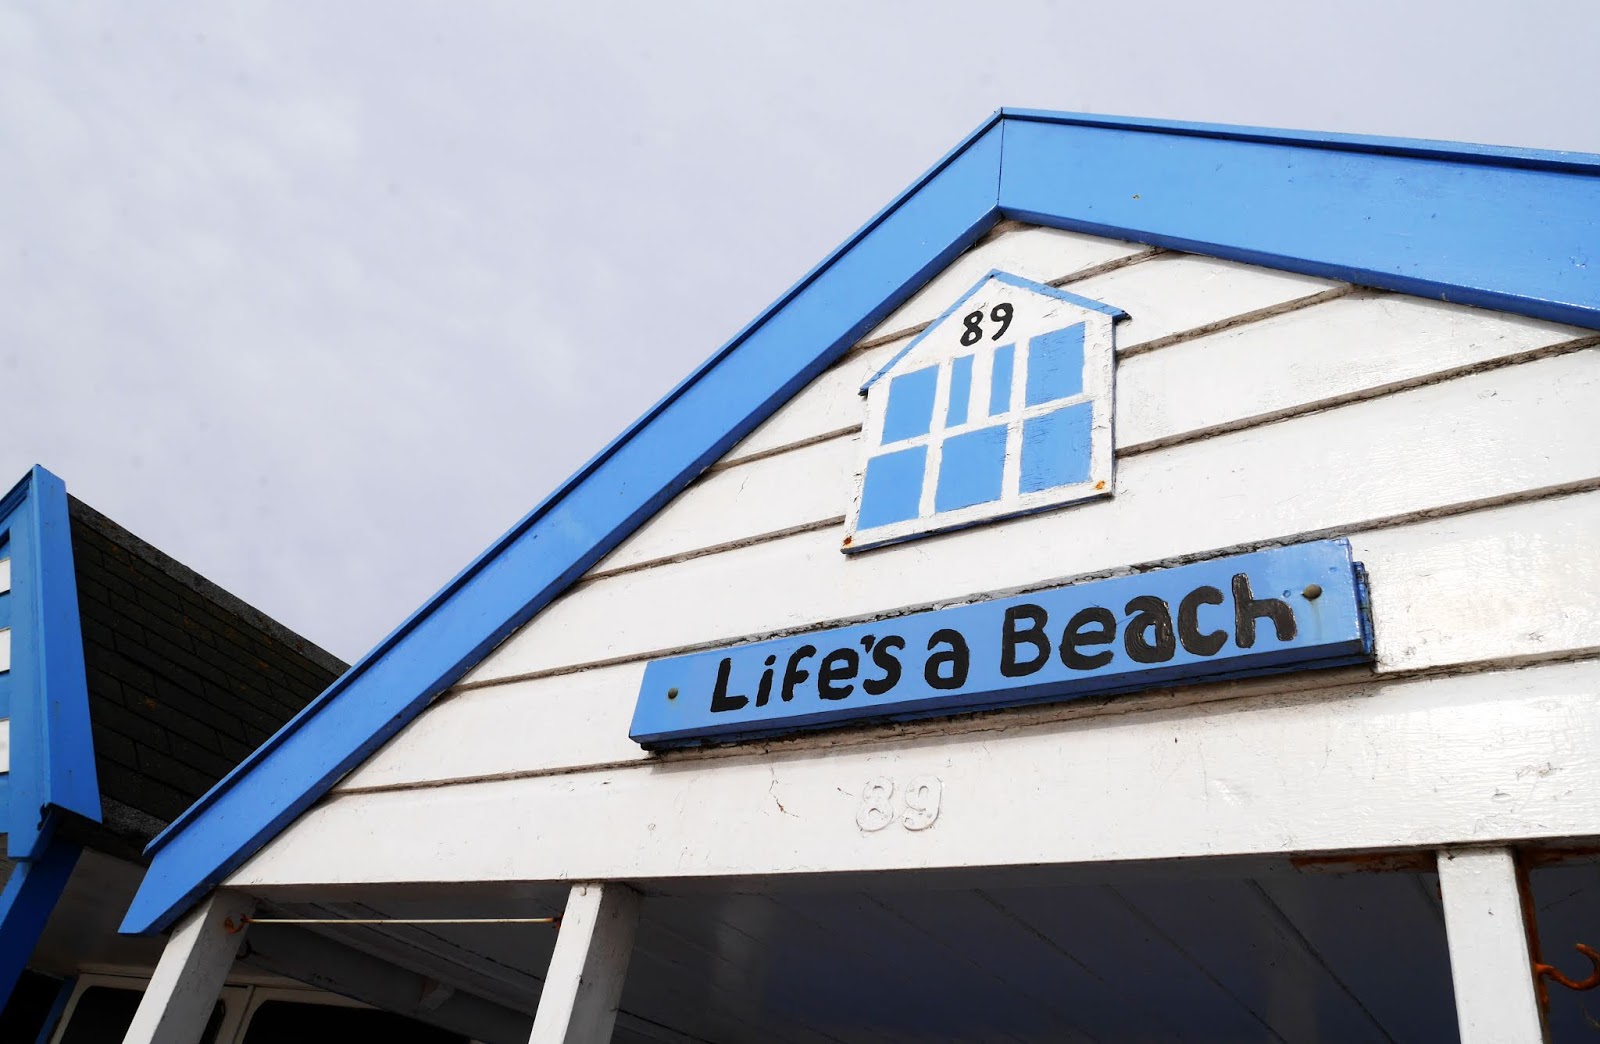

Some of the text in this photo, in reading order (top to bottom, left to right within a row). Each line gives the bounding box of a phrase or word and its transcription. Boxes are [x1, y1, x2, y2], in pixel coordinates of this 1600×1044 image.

[960, 302, 1014, 346] 89
[711, 572, 1297, 713] Life's a Beach
[855, 776, 943, 832] 89
